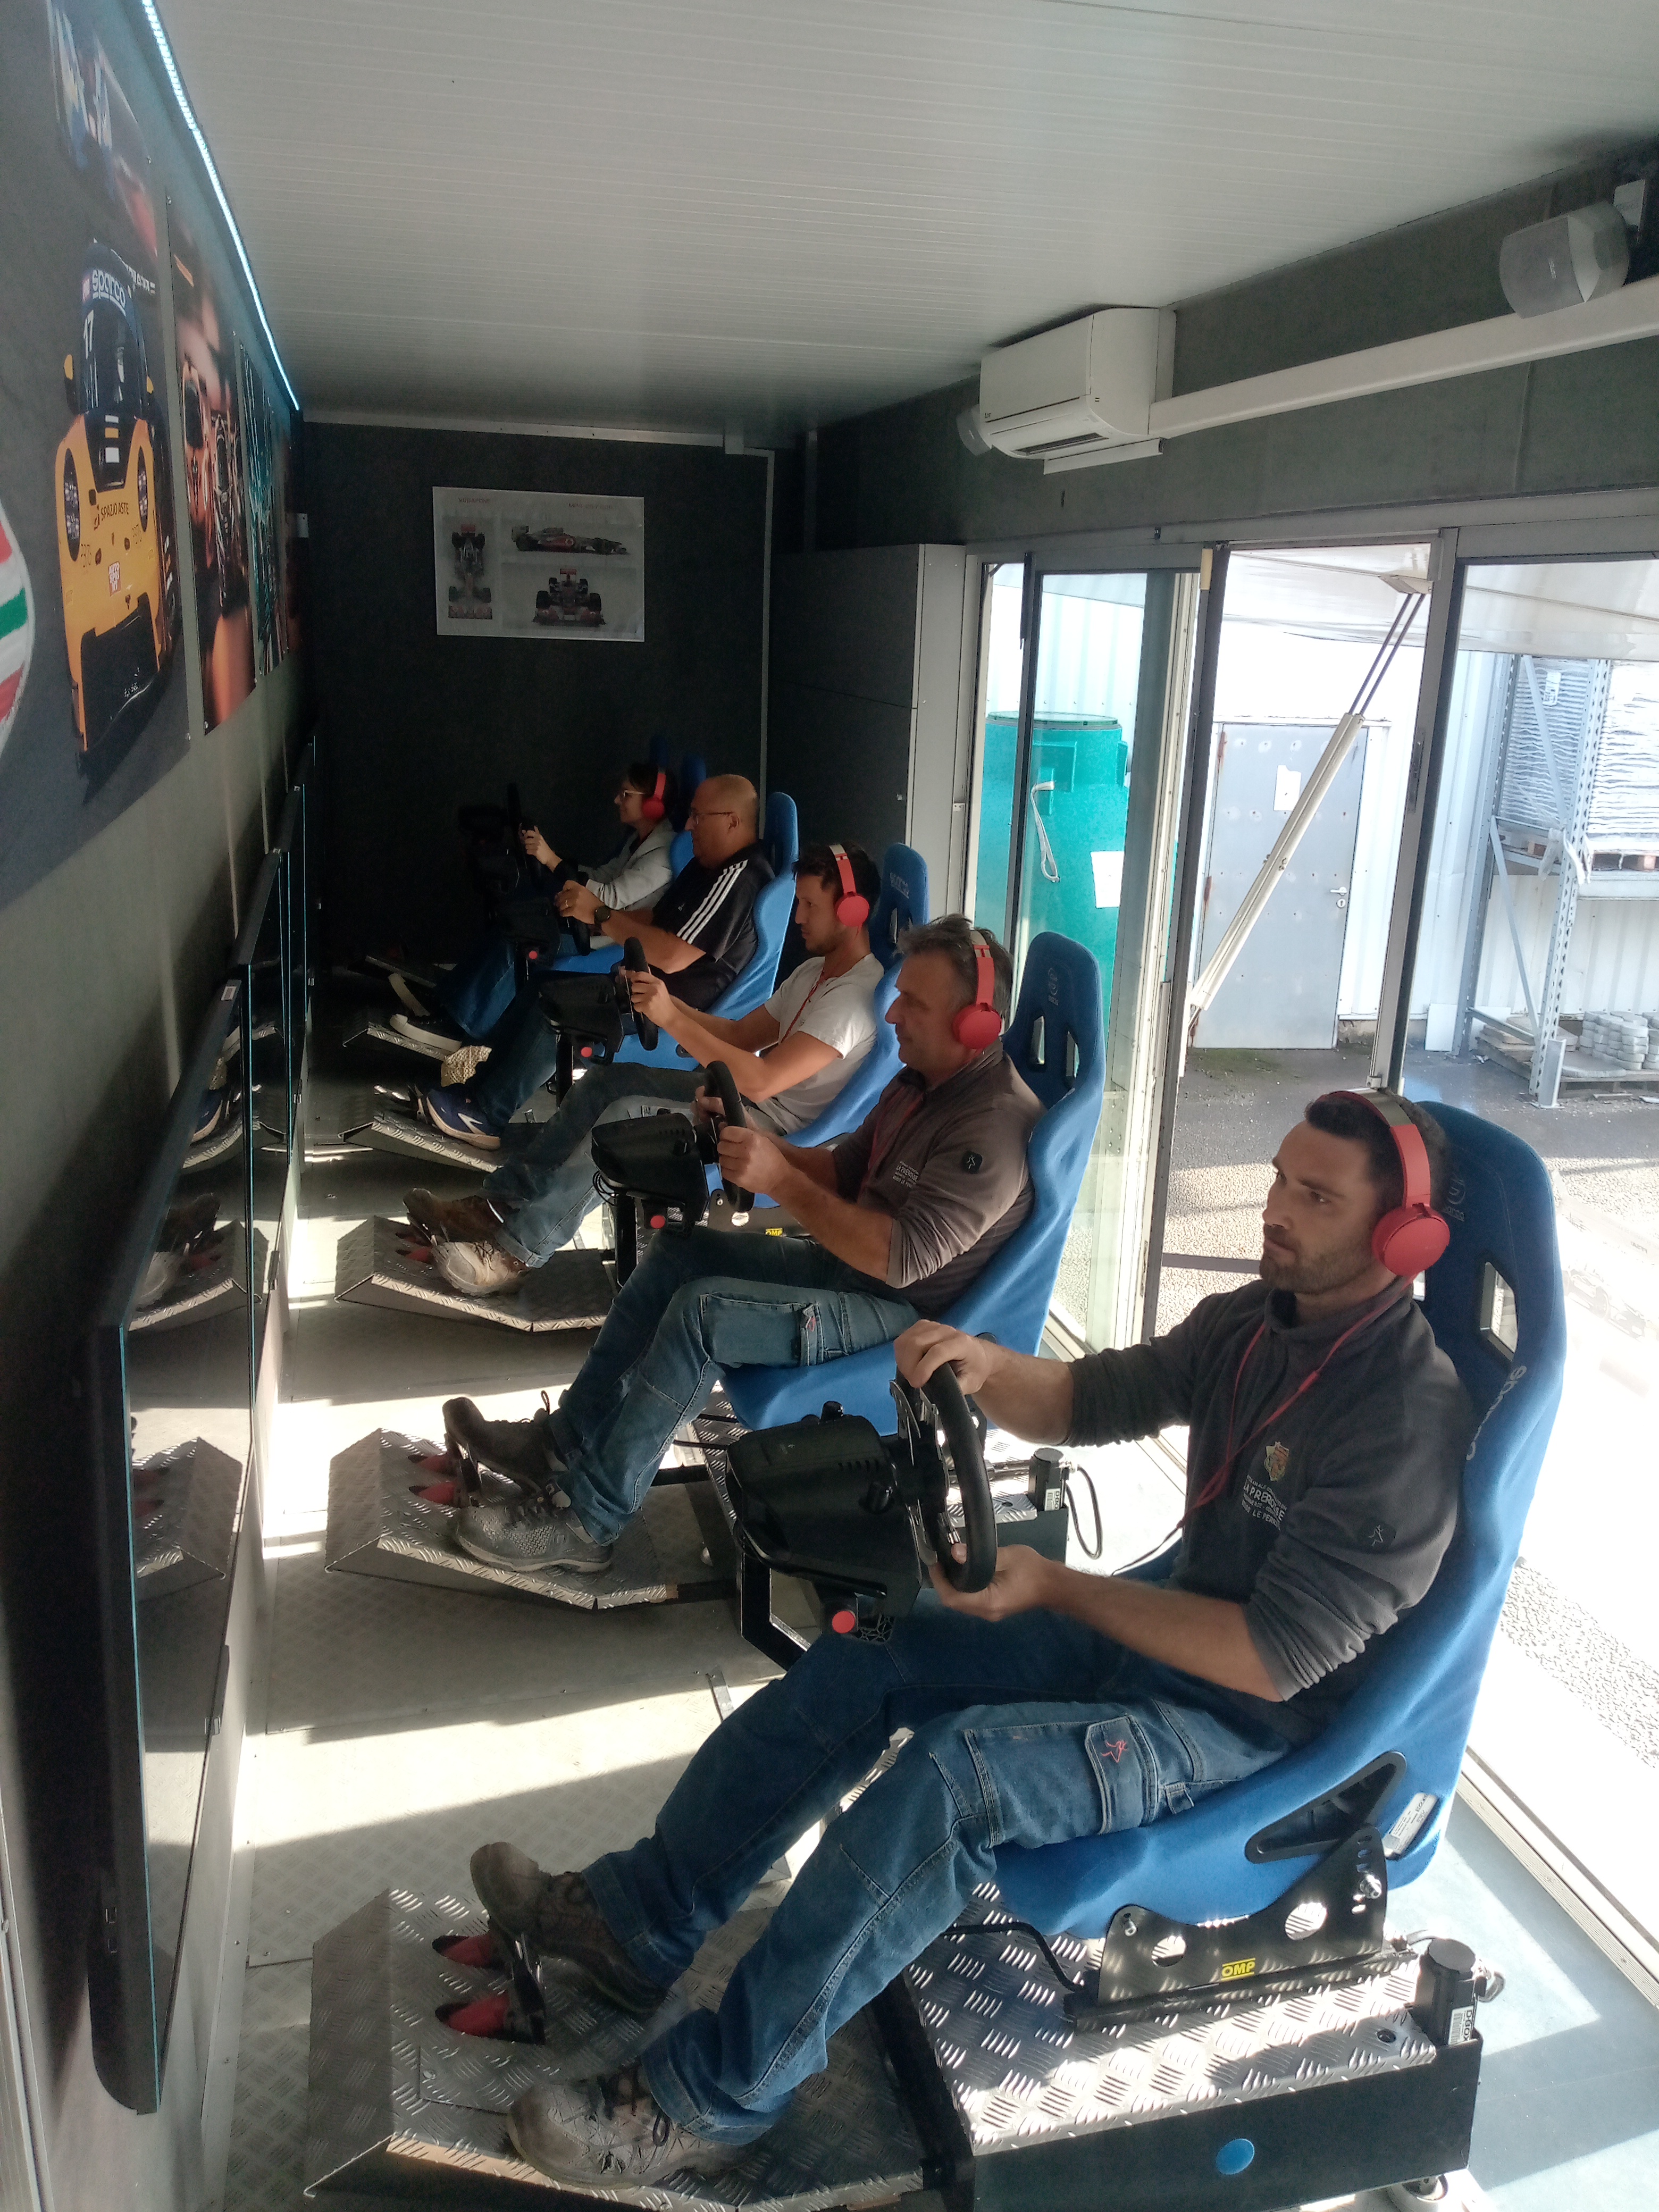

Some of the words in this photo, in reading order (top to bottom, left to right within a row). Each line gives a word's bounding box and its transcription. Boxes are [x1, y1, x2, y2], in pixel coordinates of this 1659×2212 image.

[93, 269, 125, 308] sparco
[100, 504, 118, 522] SPAZIO
[118, 502, 129, 516] ASTE
[1221, 1960, 1255, 1978] OMP
